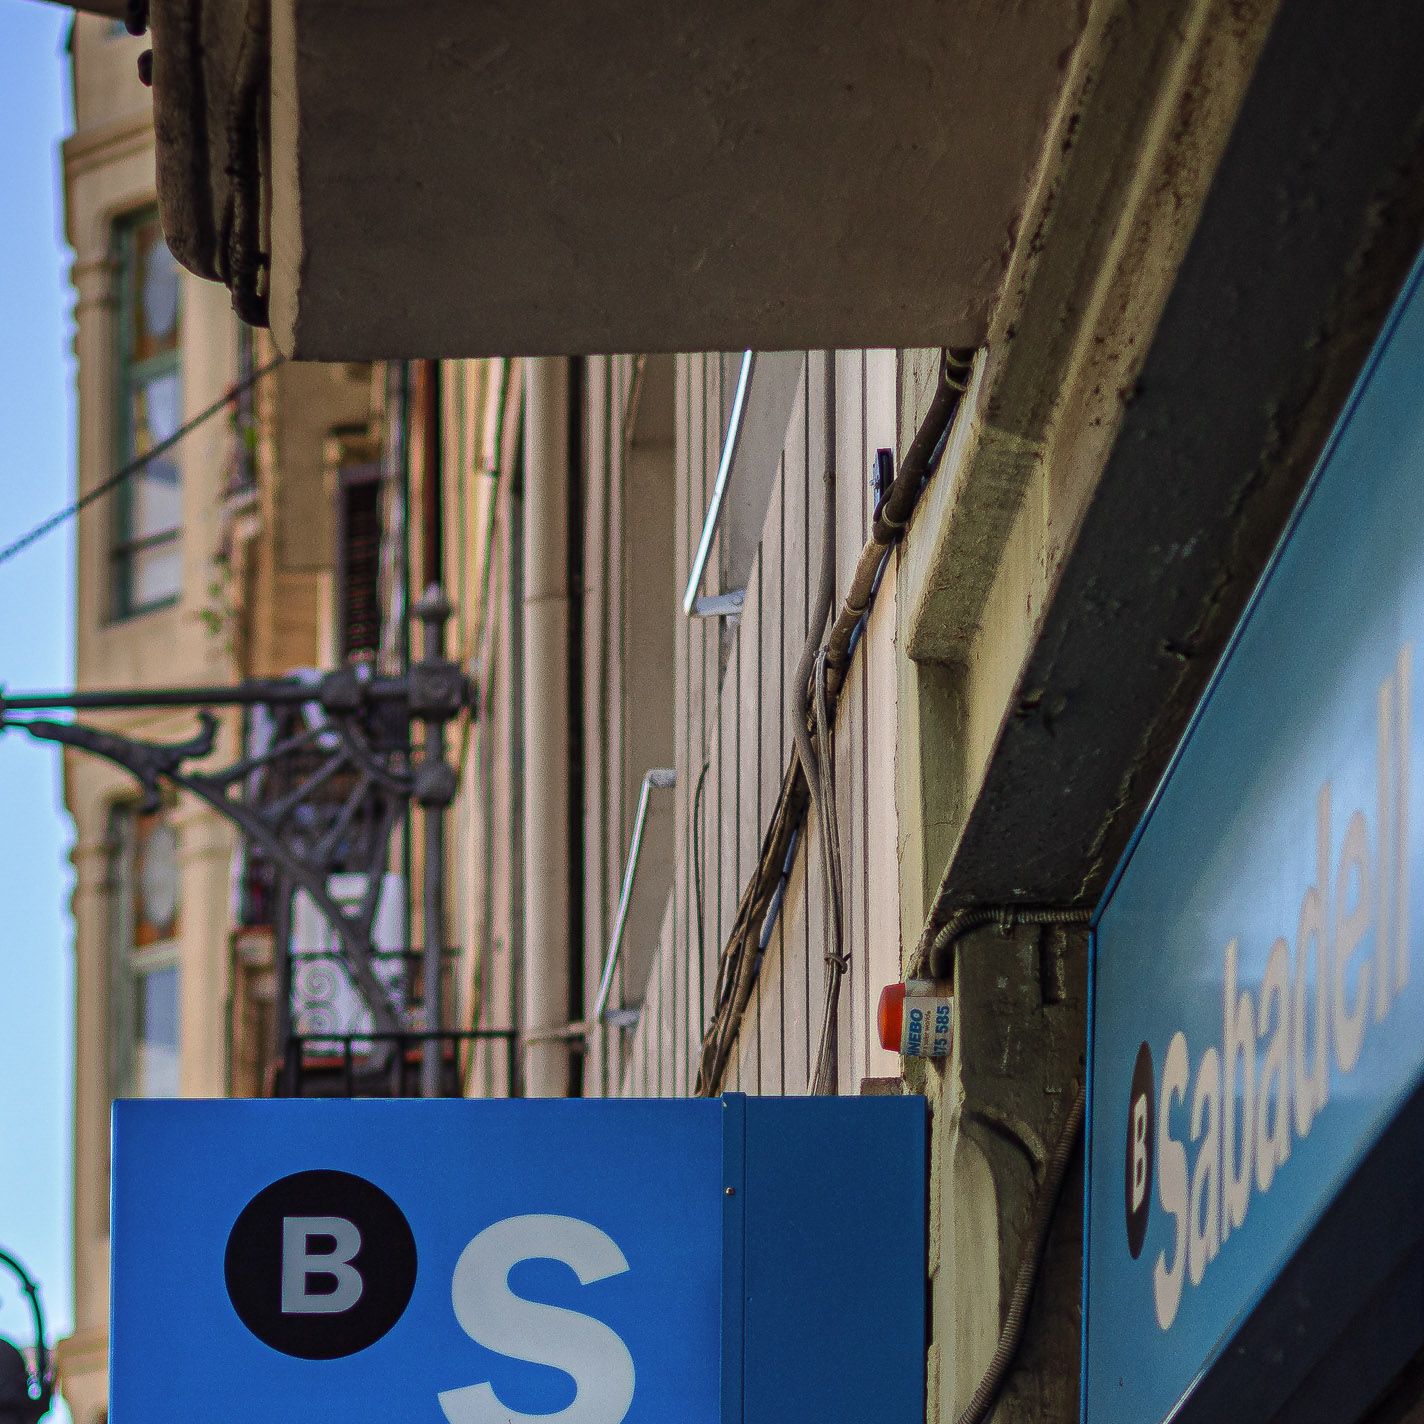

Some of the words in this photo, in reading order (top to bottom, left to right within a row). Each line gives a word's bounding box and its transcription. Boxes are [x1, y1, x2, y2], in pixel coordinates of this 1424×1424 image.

[935, 1005, 950, 1034] 585
[1153, 640, 1413, 1331] Sabadell
[280, 1215, 364, 1314] B
